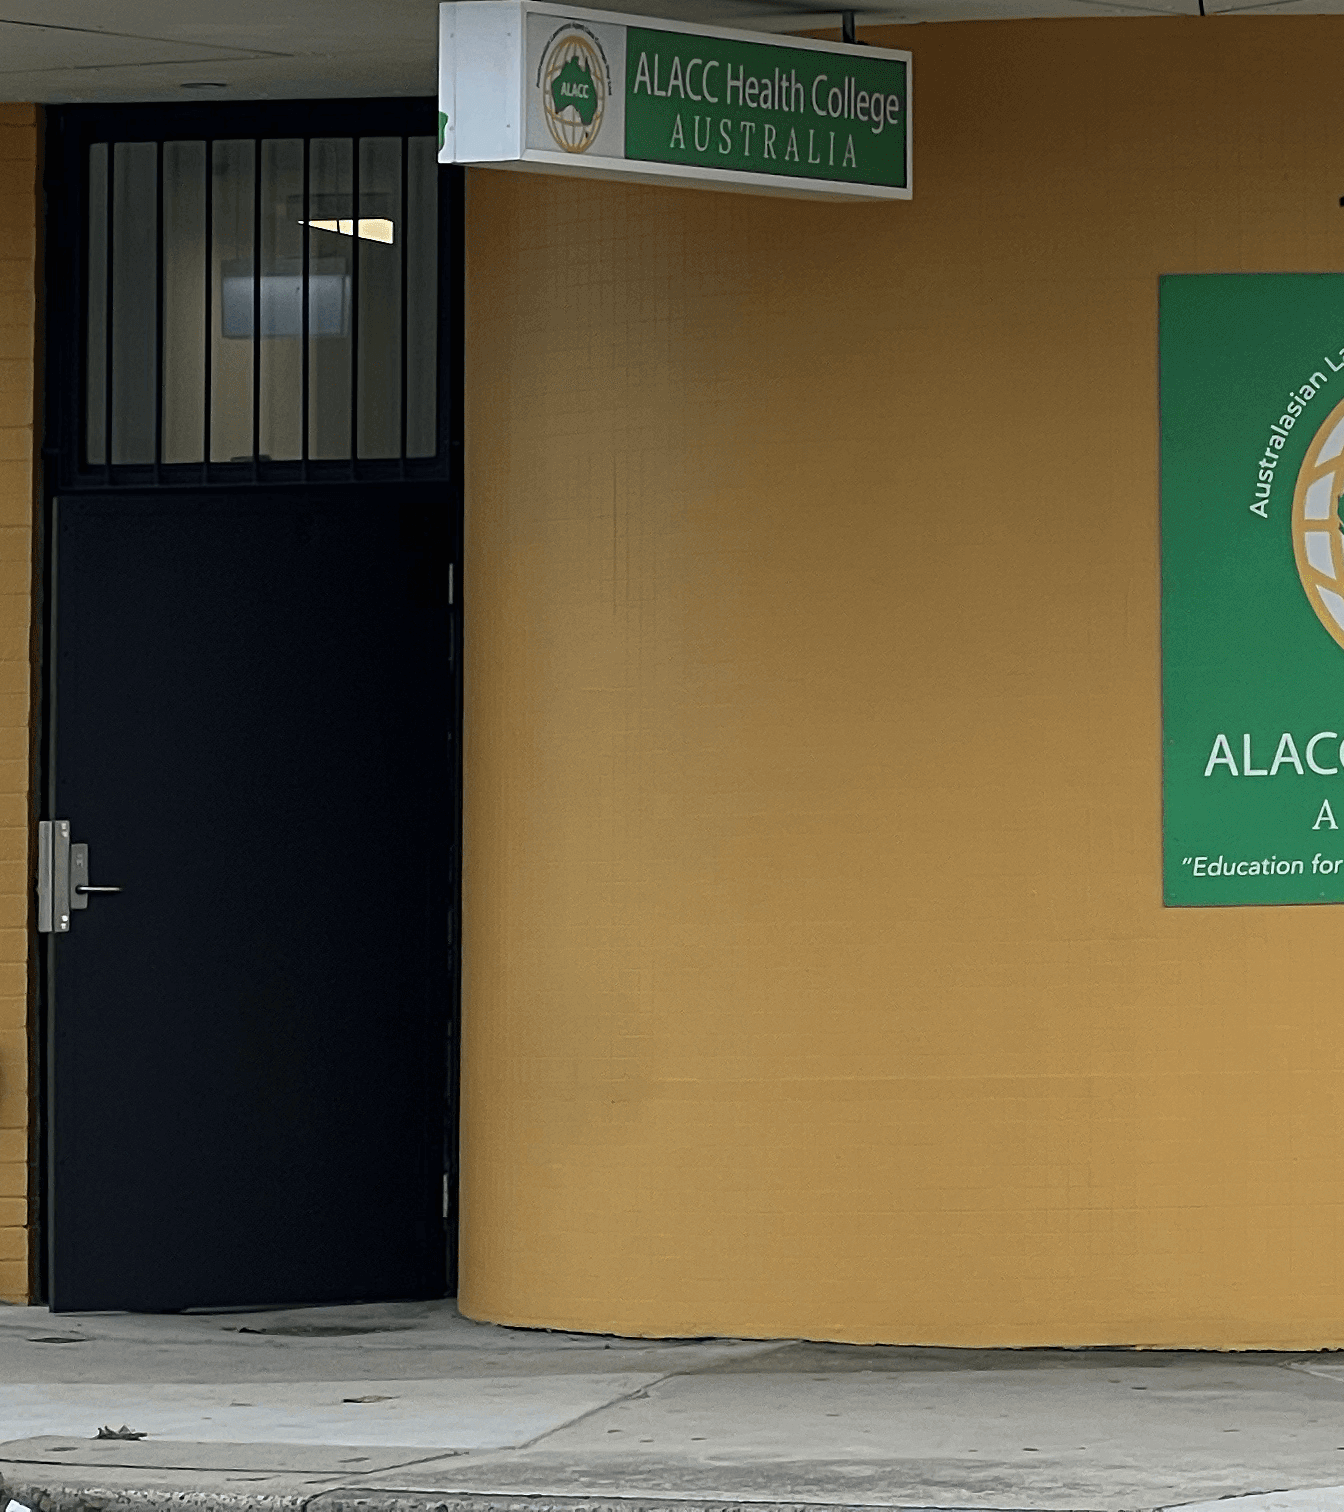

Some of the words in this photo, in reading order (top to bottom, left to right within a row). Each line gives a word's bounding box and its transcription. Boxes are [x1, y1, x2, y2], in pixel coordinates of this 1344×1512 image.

[560, 81, 590, 99] ALACC
[633, 51, 720, 104] ALACC
[726, 62, 805, 114] Health
[811, 74, 900, 135] College
[669, 113, 857, 168] AUSTRALIA
[1249, 371, 1328, 519] Australasian
[1311, 852, 1344, 875] for
